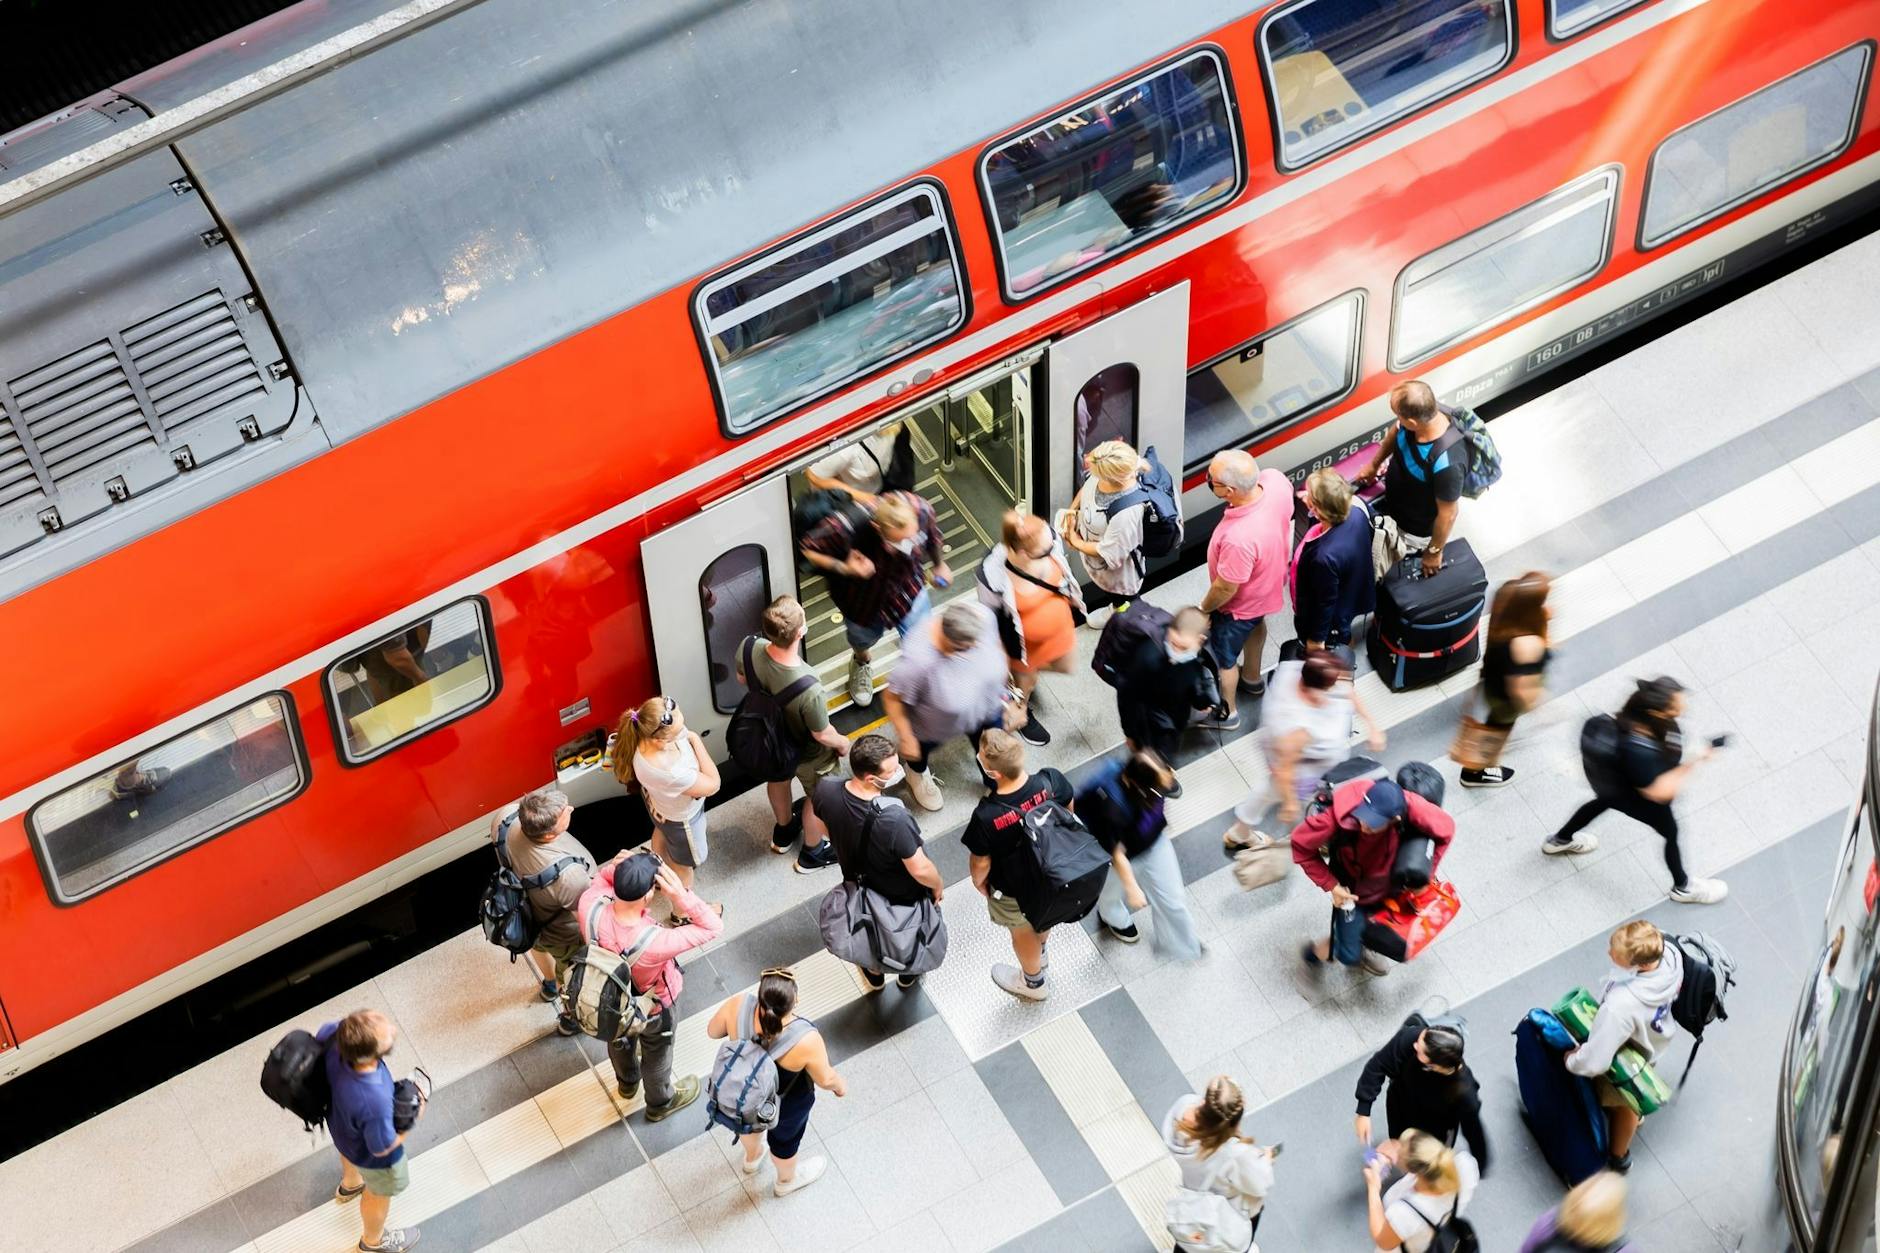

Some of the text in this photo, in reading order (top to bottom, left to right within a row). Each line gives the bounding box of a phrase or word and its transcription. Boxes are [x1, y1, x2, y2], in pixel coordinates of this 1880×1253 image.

[1536, 327, 1593, 364] 160 DB
[1312, 455, 1332, 474] 80
